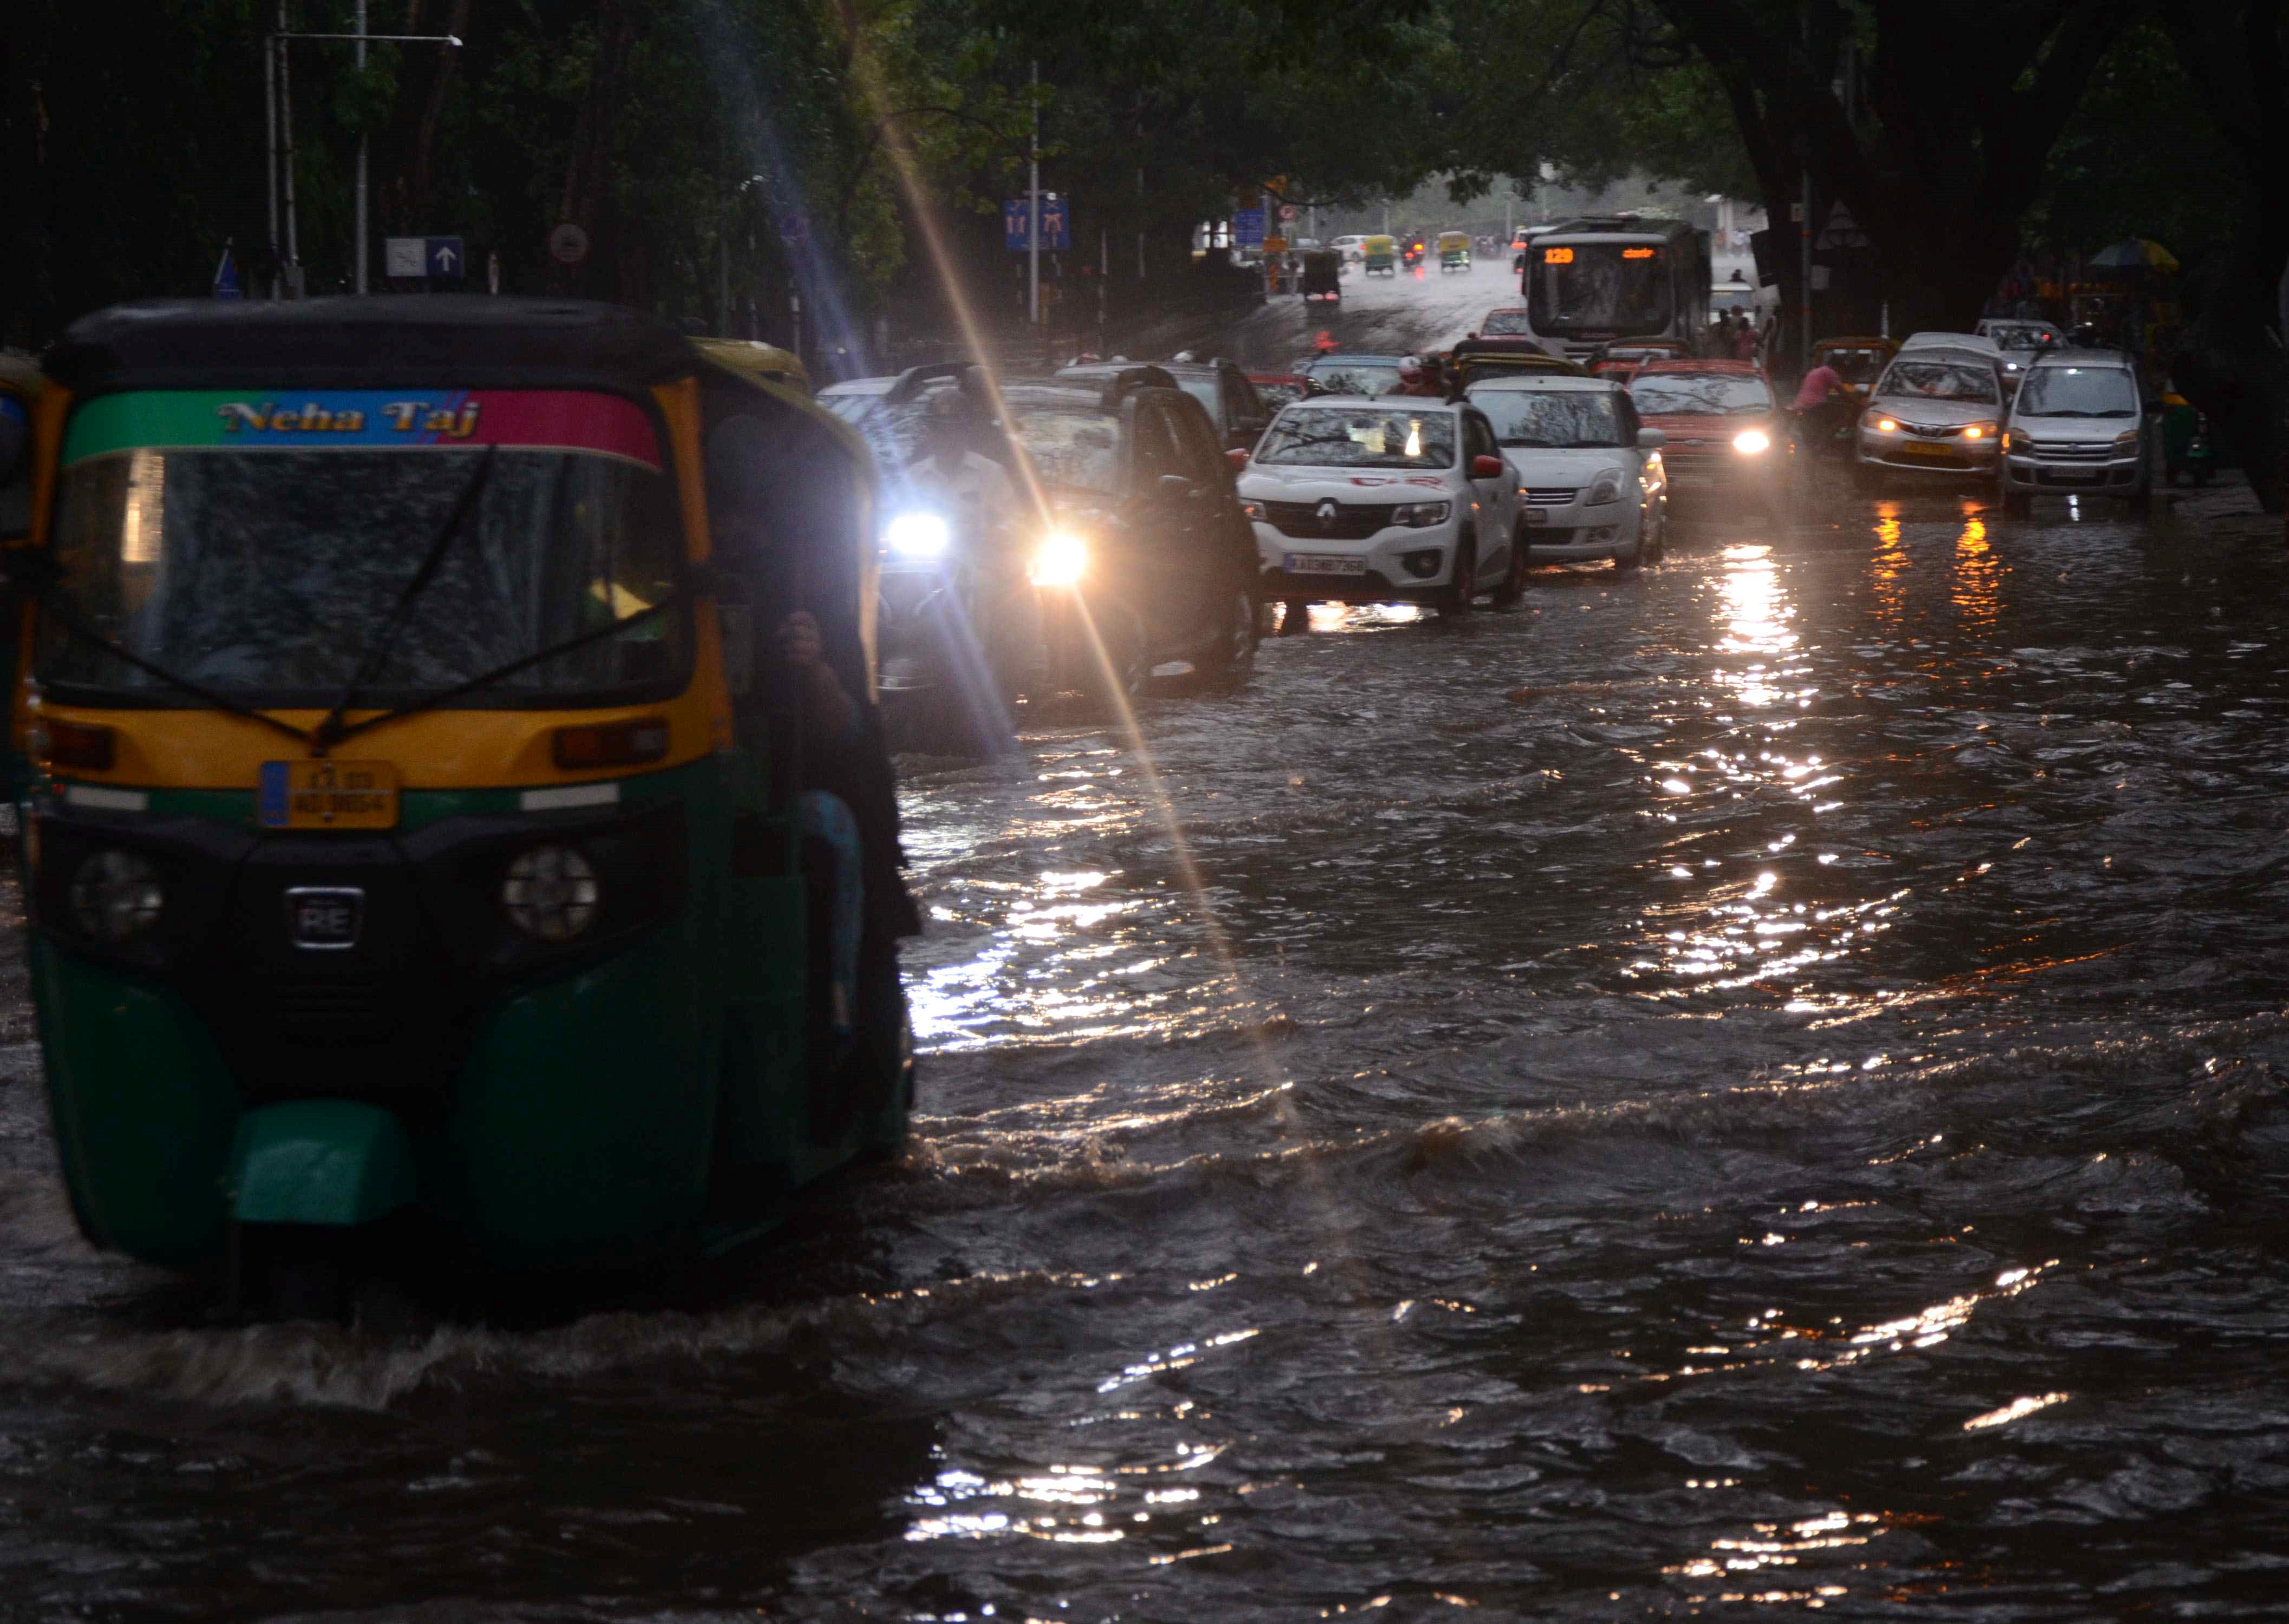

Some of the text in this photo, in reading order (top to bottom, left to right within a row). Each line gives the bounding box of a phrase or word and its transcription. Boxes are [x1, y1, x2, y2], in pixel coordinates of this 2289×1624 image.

[217, 398, 482, 440] Neha Taj
[298, 907, 352, 935] RE
